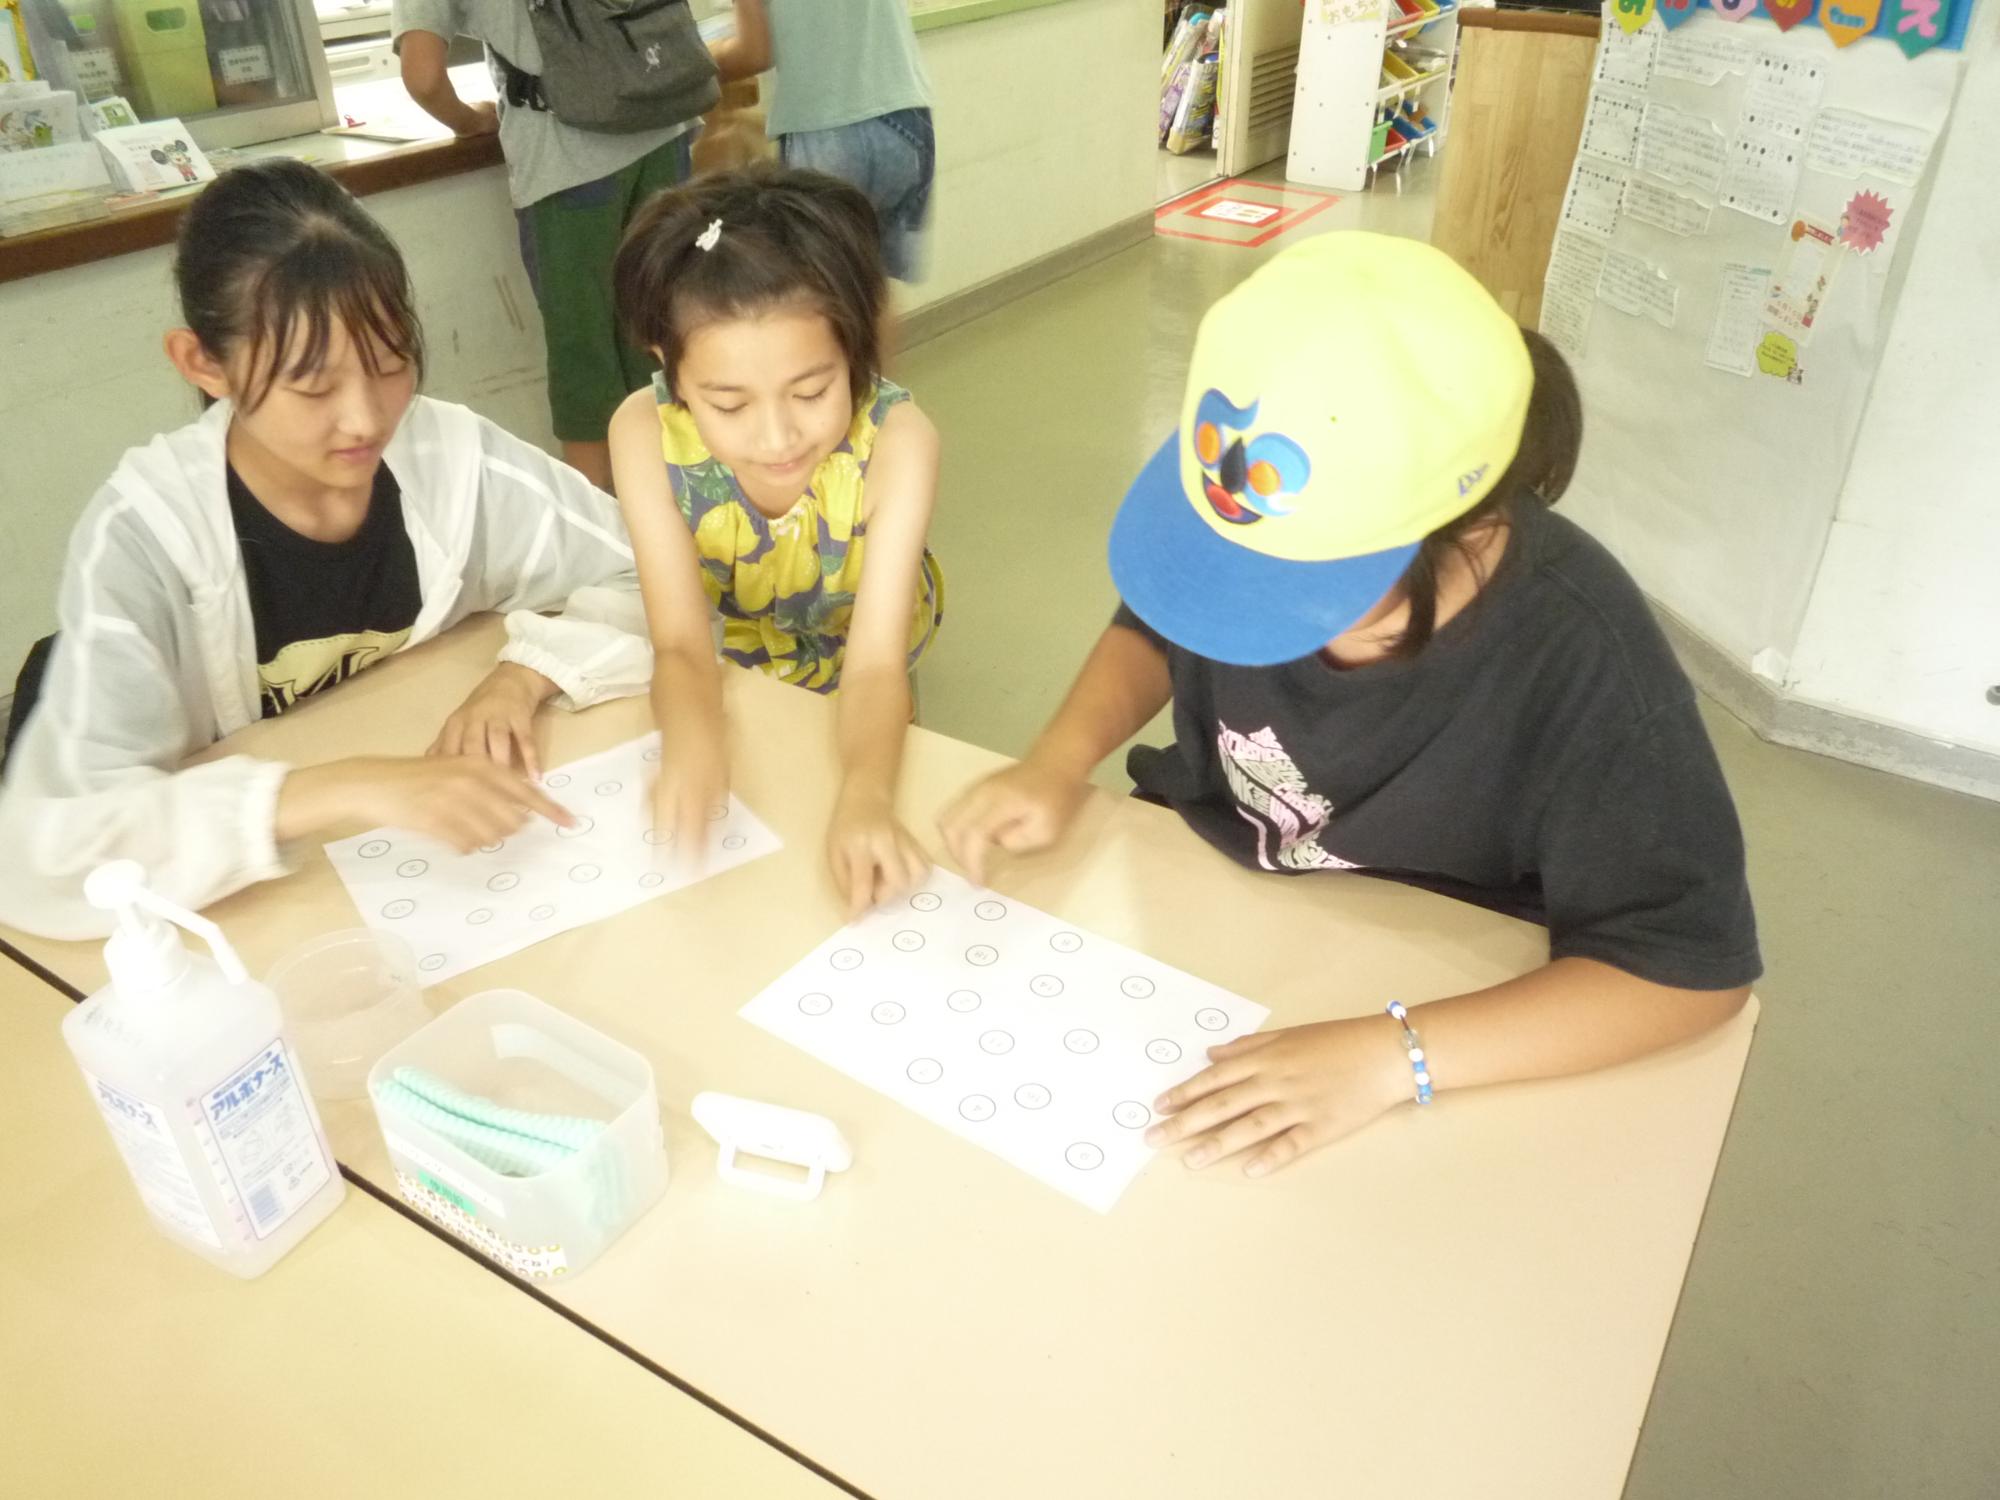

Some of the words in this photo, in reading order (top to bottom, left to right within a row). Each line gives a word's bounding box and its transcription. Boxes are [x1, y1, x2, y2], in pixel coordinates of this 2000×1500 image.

[209, 1053, 285, 1121] アルボナース
